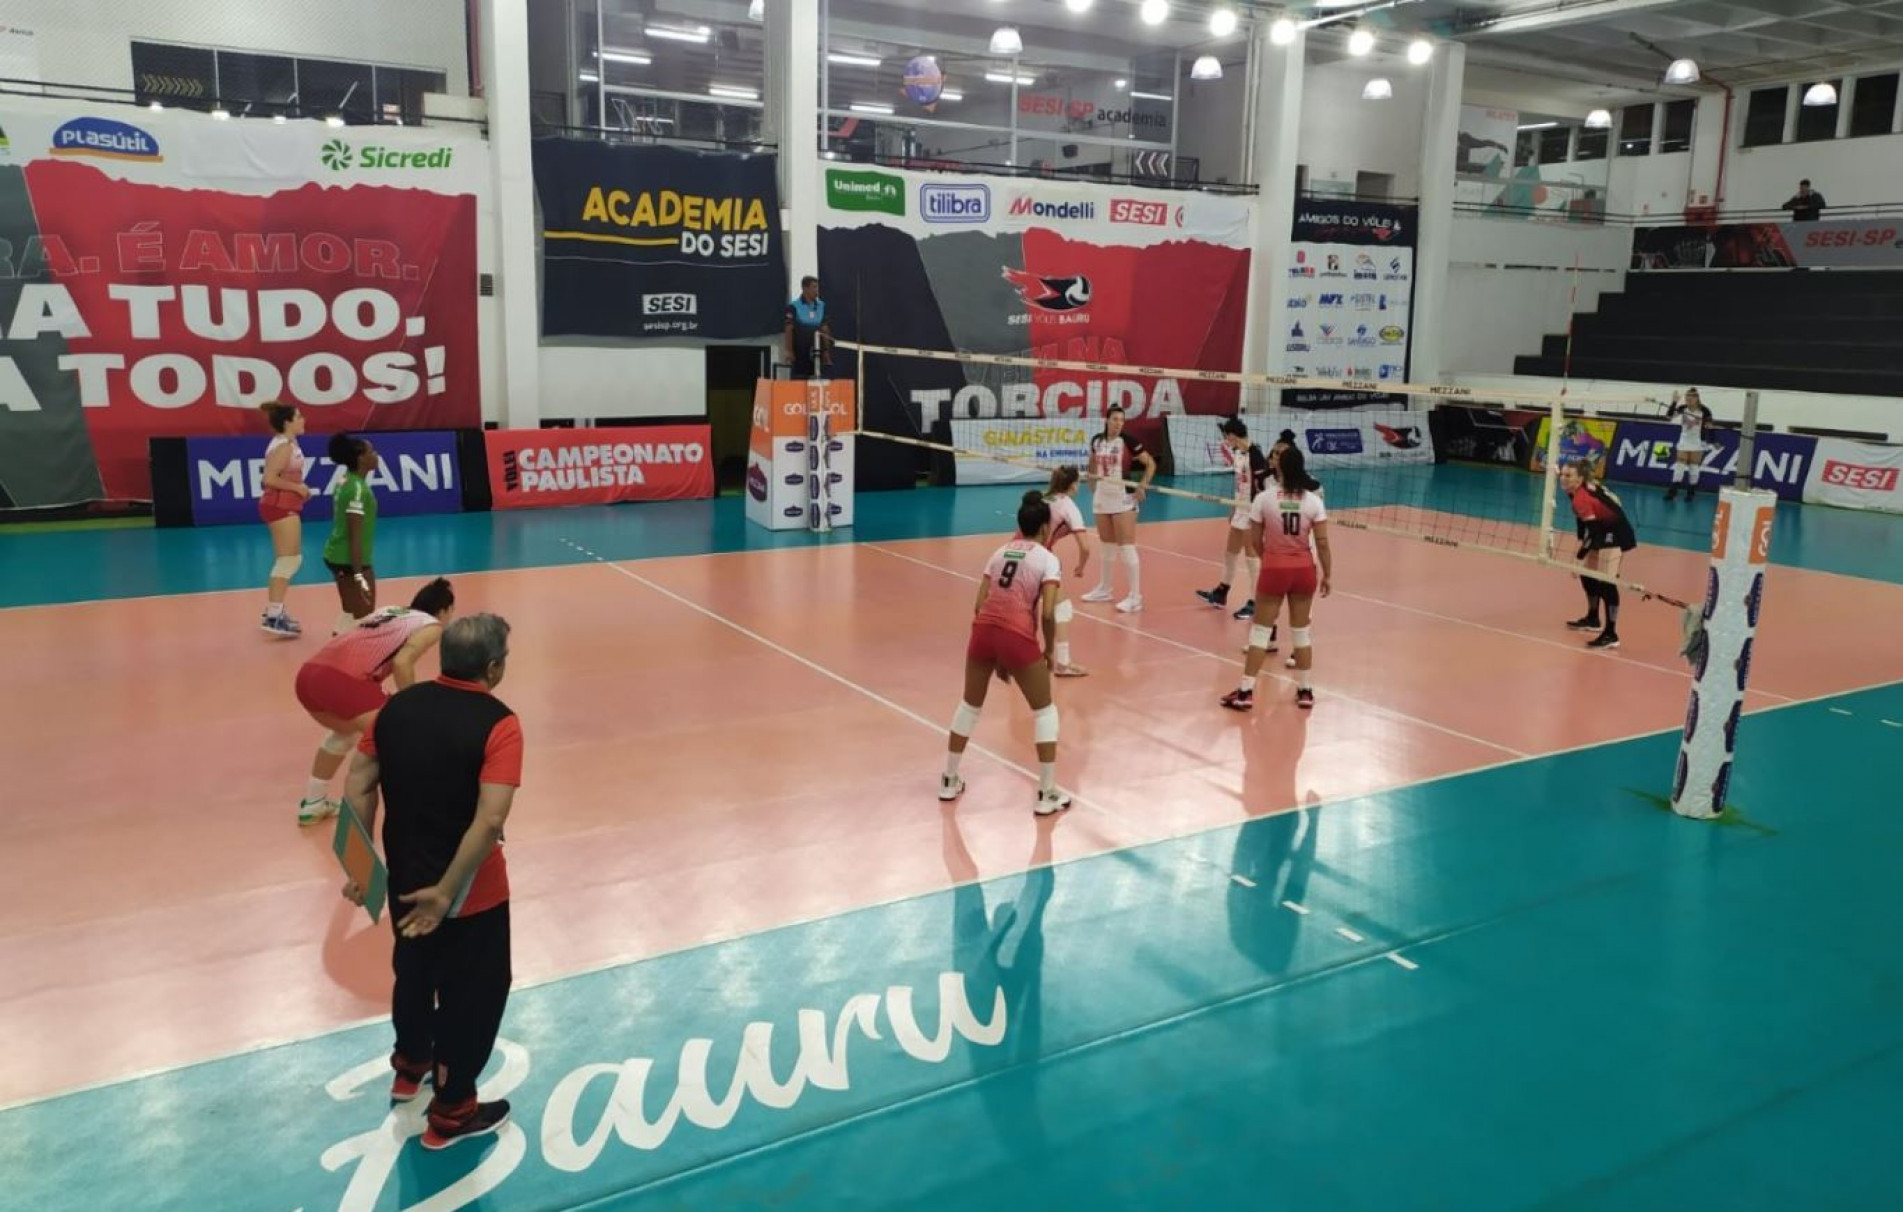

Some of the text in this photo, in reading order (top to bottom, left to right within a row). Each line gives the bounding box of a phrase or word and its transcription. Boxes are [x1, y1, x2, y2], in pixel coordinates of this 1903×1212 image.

[1097, 107, 1167, 127] academia
[359, 146, 453, 170] Sicredi
[835, 180, 880, 193] Unimed
[582, 187, 768, 231] ACADEMIA
[929, 194, 981, 214] tilibra
[1009, 197, 1095, 220] Mondelli
[1114, 203, 1163, 223] SESI
[116, 221, 167, 273] É
[179, 230, 421, 281] AMOR.
[681, 230, 768, 257] DO SESI
[1806, 228, 1897, 249] SESI-SP
[108, 283, 426, 342] TUDO.
[646, 297, 692, 312] SESI
[58, 346, 447, 410] TODOS!
[910, 378, 1188, 434] TORCIDA
[518, 442, 704, 470] CAMPEONATO
[521, 464, 646, 492] PAULISTA
[1827, 465, 1894, 489] SESI
[1281, 512, 1301, 536] 10
[998, 560, 1018, 589] 9
[320, 971, 1008, 1212] Bauru
